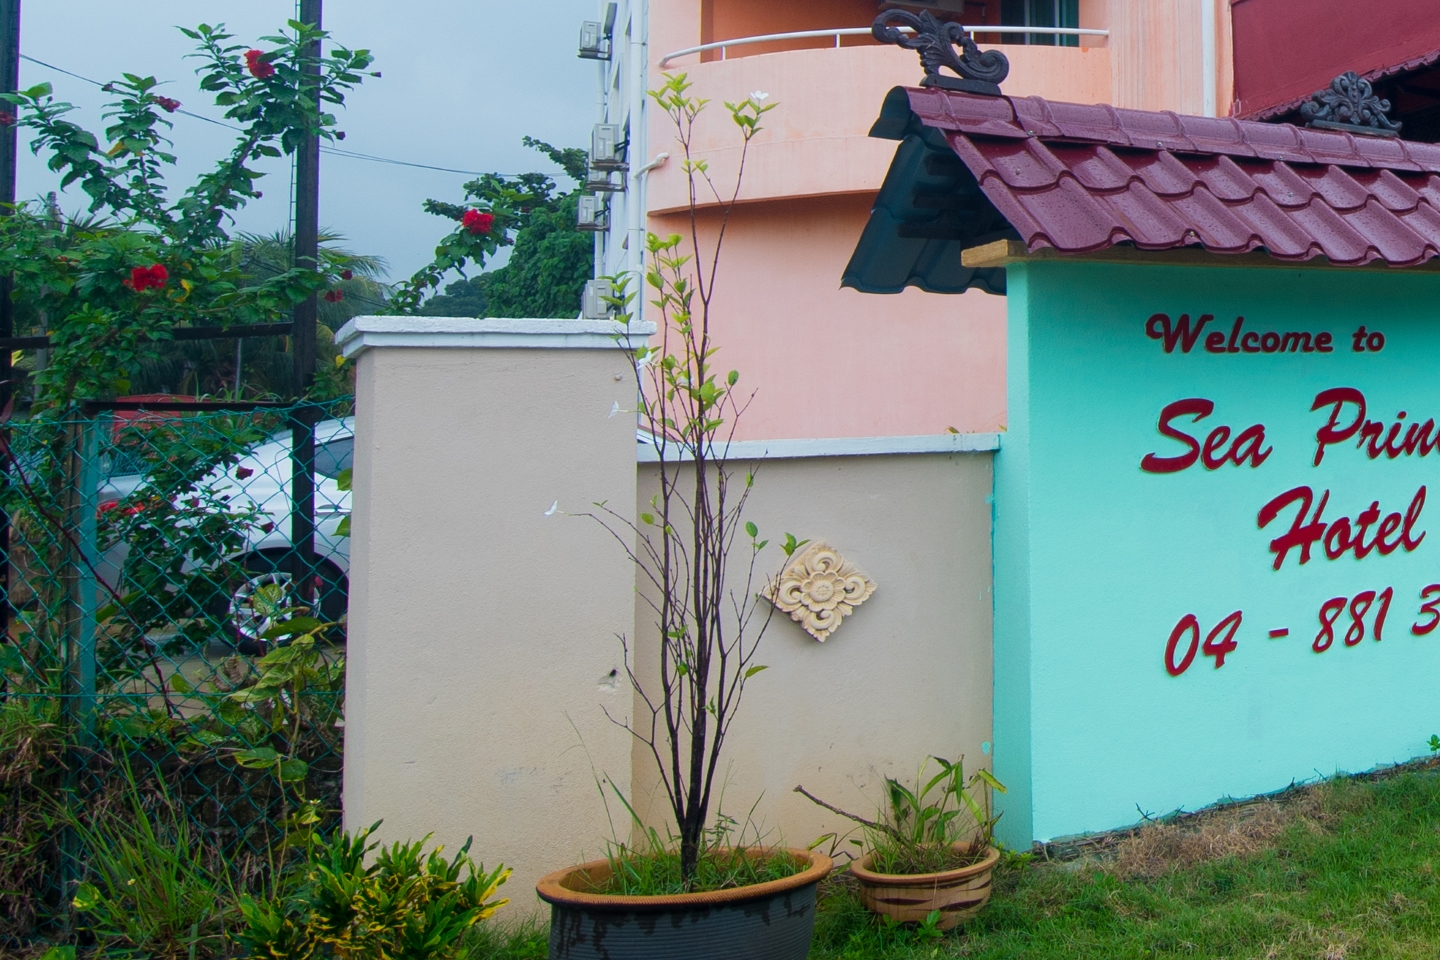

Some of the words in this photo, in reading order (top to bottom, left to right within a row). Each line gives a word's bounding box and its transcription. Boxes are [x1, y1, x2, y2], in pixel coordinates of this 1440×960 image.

[1145, 313, 1334, 354] Welcome
[1352, 325, 1385, 353] to
[1139, 398, 1273, 474] Sea
[1256, 485, 1427, 570] Hotel
[1163, 610, 1243, 676] 04
[1311, 587, 1394, 653] 881
